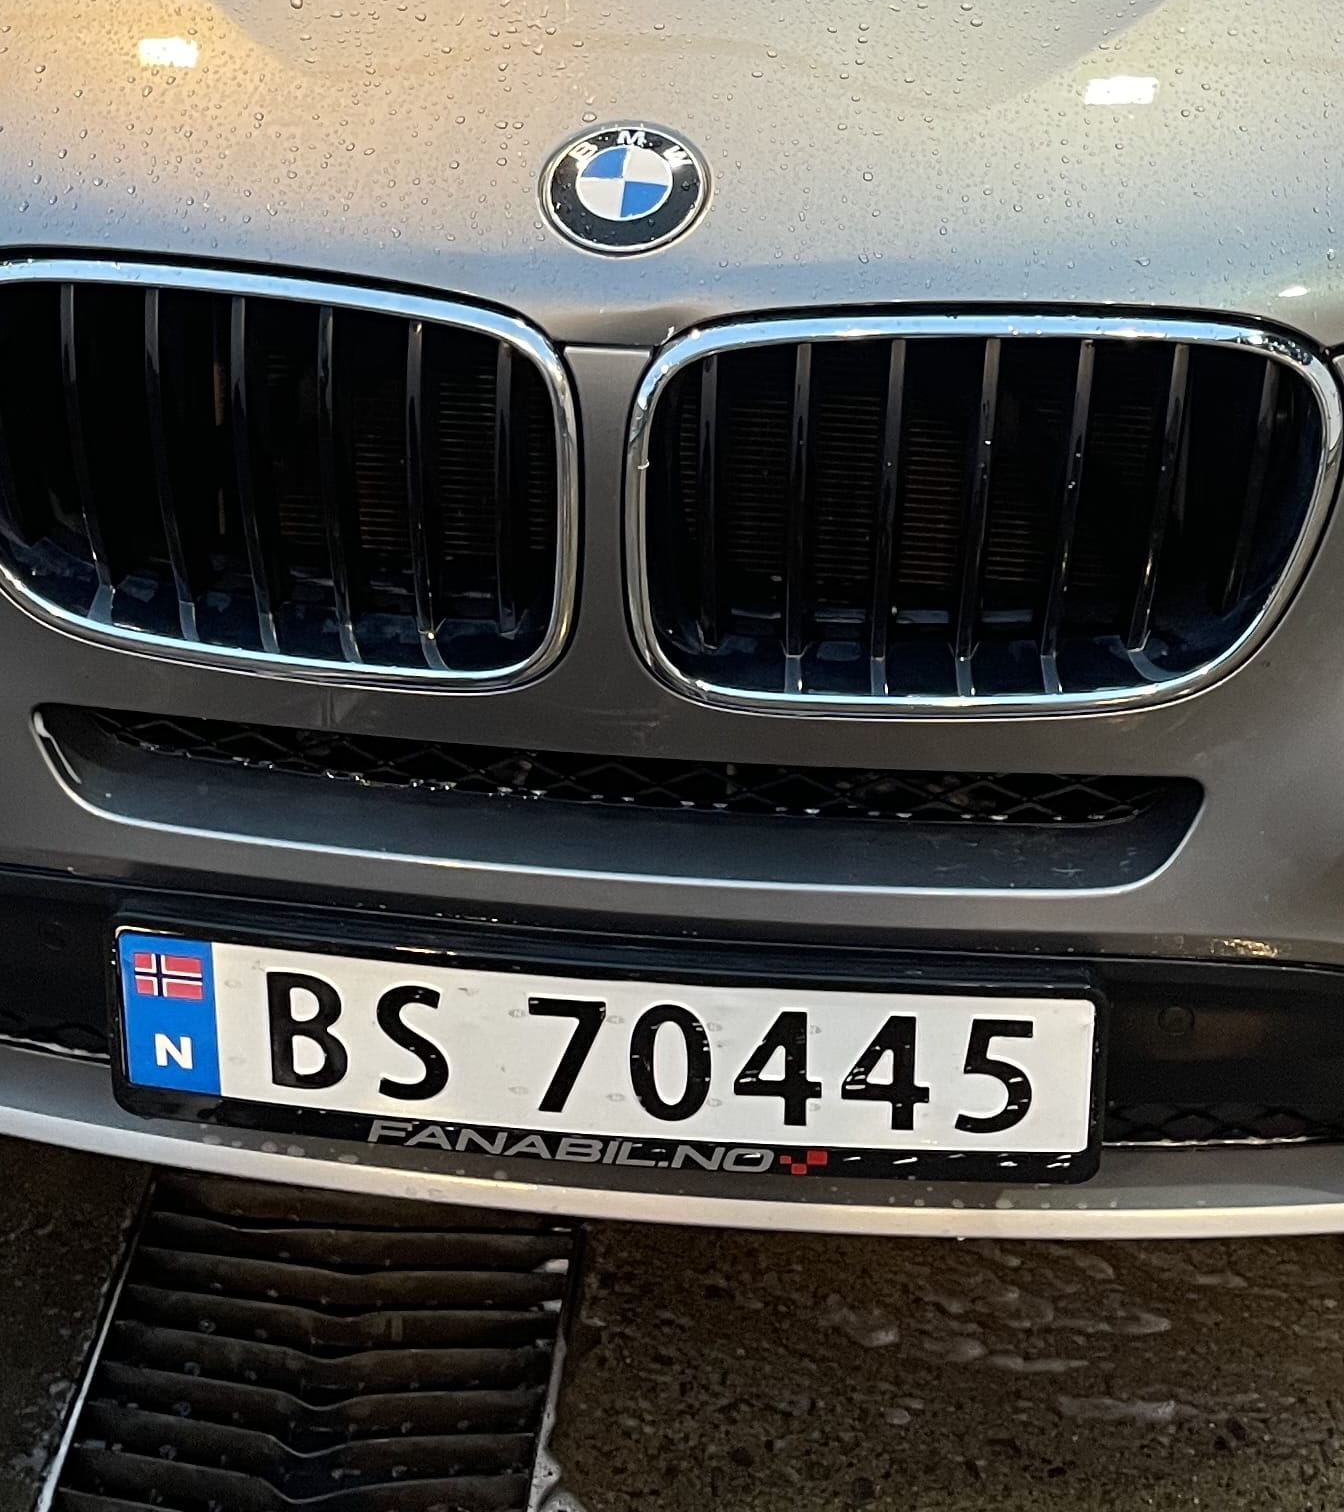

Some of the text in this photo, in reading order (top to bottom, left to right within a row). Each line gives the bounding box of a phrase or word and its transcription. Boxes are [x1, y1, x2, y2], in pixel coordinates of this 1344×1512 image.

[567, 130, 693, 169] BMW
[155, 1033, 193, 1071] N
[265, 970, 1035, 1135] BS 70445
[366, 1118, 775, 1174] FANABIL.NO
